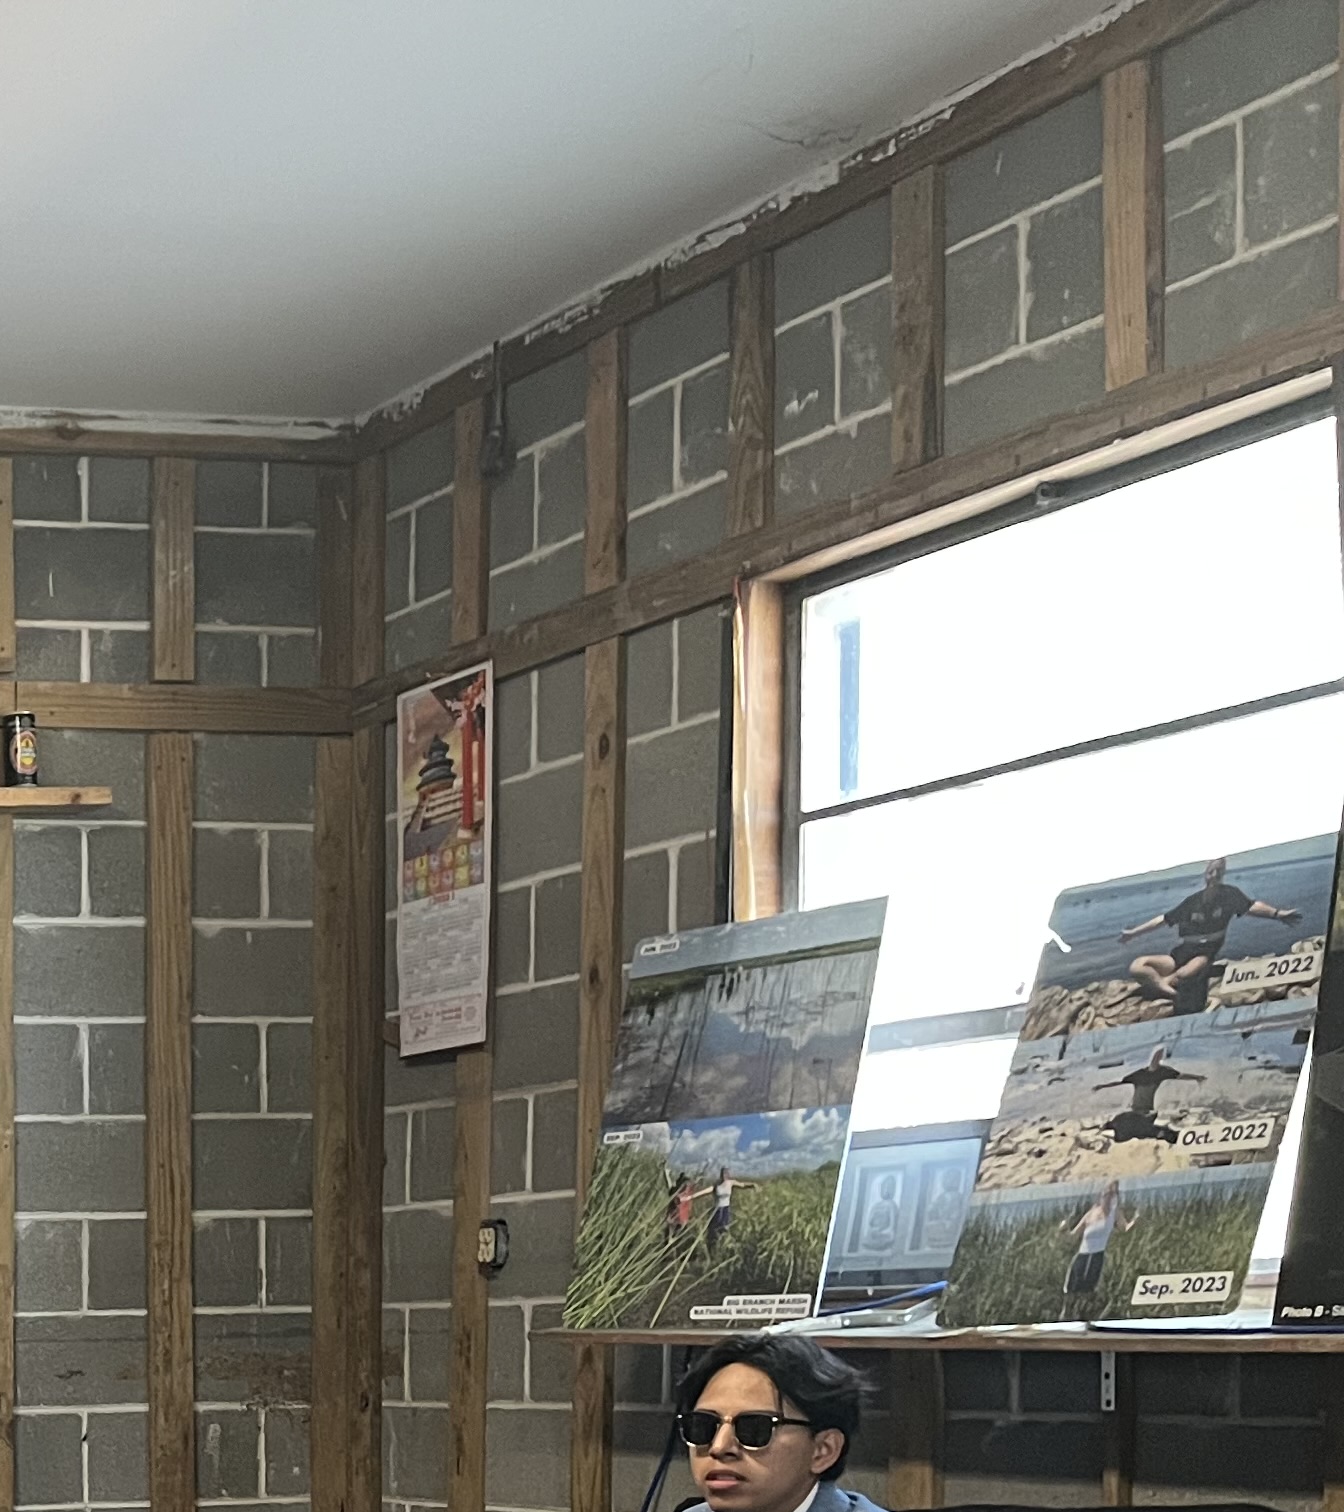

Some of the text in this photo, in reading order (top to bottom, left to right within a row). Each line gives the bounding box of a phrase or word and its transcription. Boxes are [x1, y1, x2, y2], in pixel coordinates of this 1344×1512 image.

[1226, 956, 1314, 984] Jun. 2022
[1182, 1122, 1268, 1146] Oct. 2022
[1139, 1275, 1227, 1299] Sep. 2023
